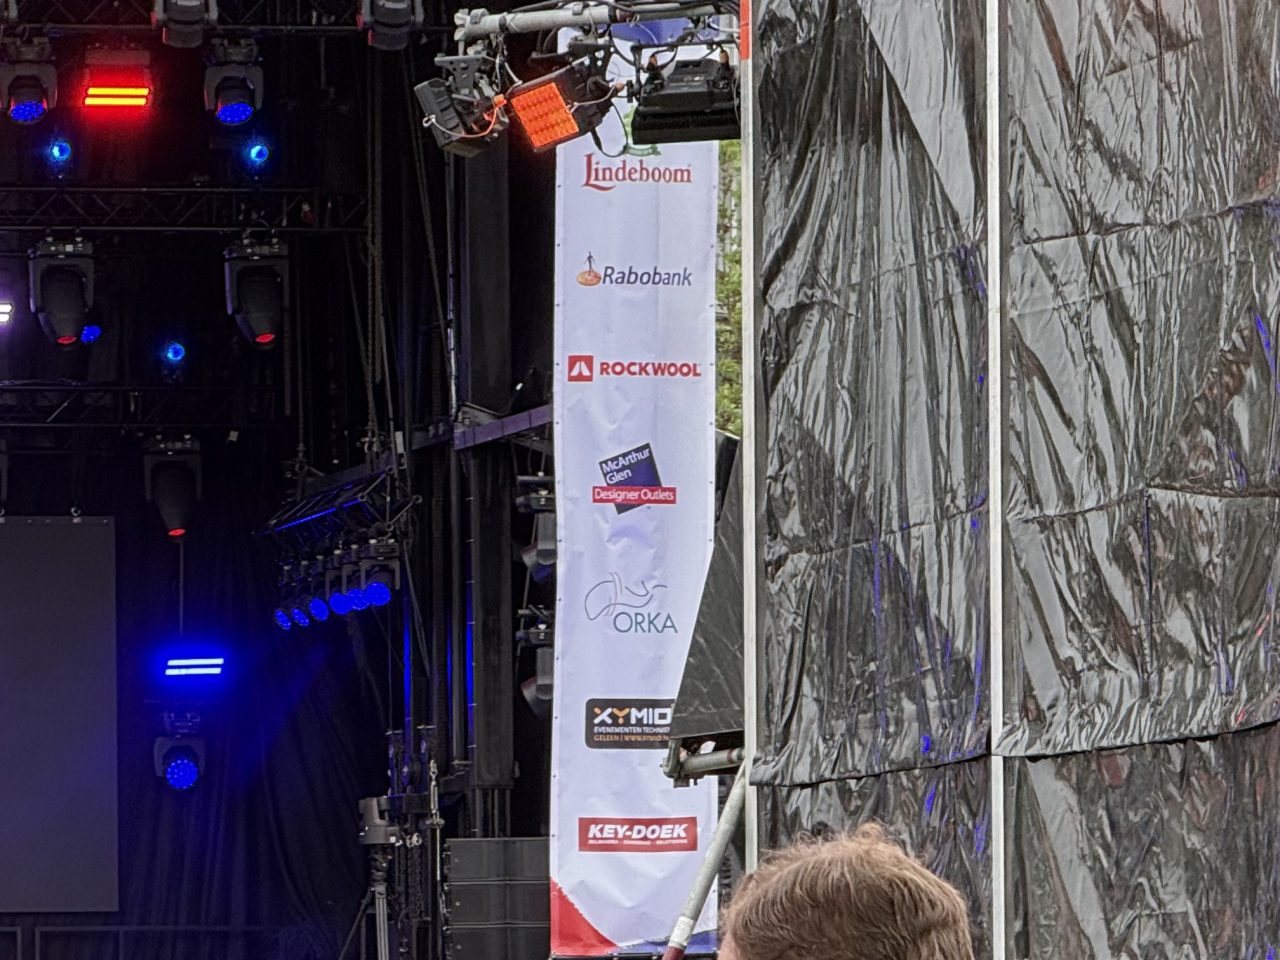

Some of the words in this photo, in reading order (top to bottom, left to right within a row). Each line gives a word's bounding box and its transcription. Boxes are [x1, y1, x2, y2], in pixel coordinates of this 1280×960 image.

[582, 153, 692, 191] Lindeboom
[602, 265, 693, 286] Rabobank
[600, 361, 702, 377] ROCKWOOL
[601, 447, 650, 474] McArthur
[606, 468, 632, 484] Glen
[594, 488, 640, 502] Designer
[640, 489, 674, 501] Outlets
[613, 611, 678, 634] ORKA
[587, 824, 688, 839] KEY-DOEK
